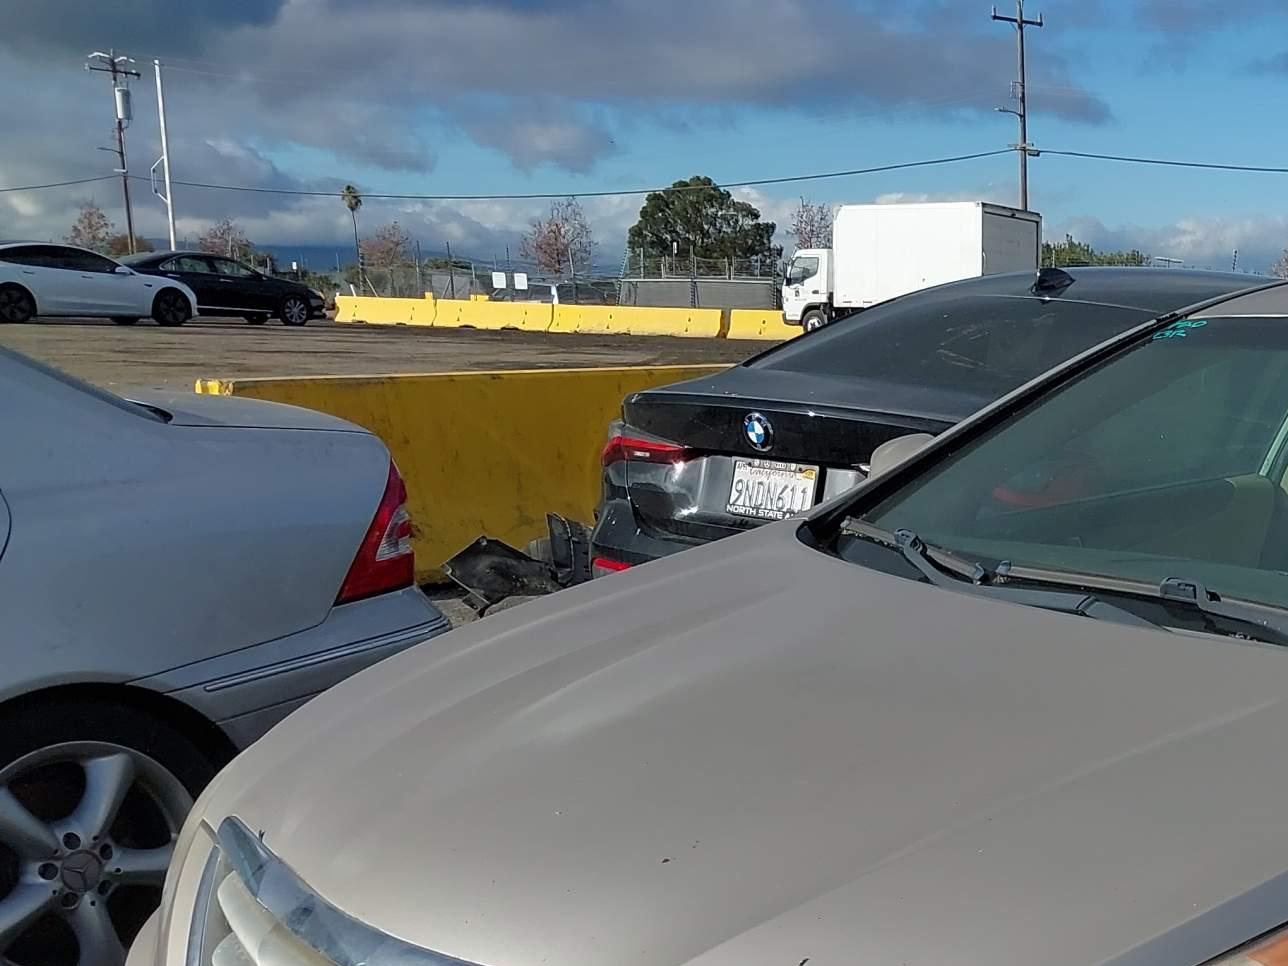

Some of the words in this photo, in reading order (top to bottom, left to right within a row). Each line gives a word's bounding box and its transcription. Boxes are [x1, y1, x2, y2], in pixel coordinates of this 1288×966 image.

[732, 479, 808, 511] 9NDN611
[726, 504, 757, 516] NORTH
[758, 509, 783, 519] STATE
